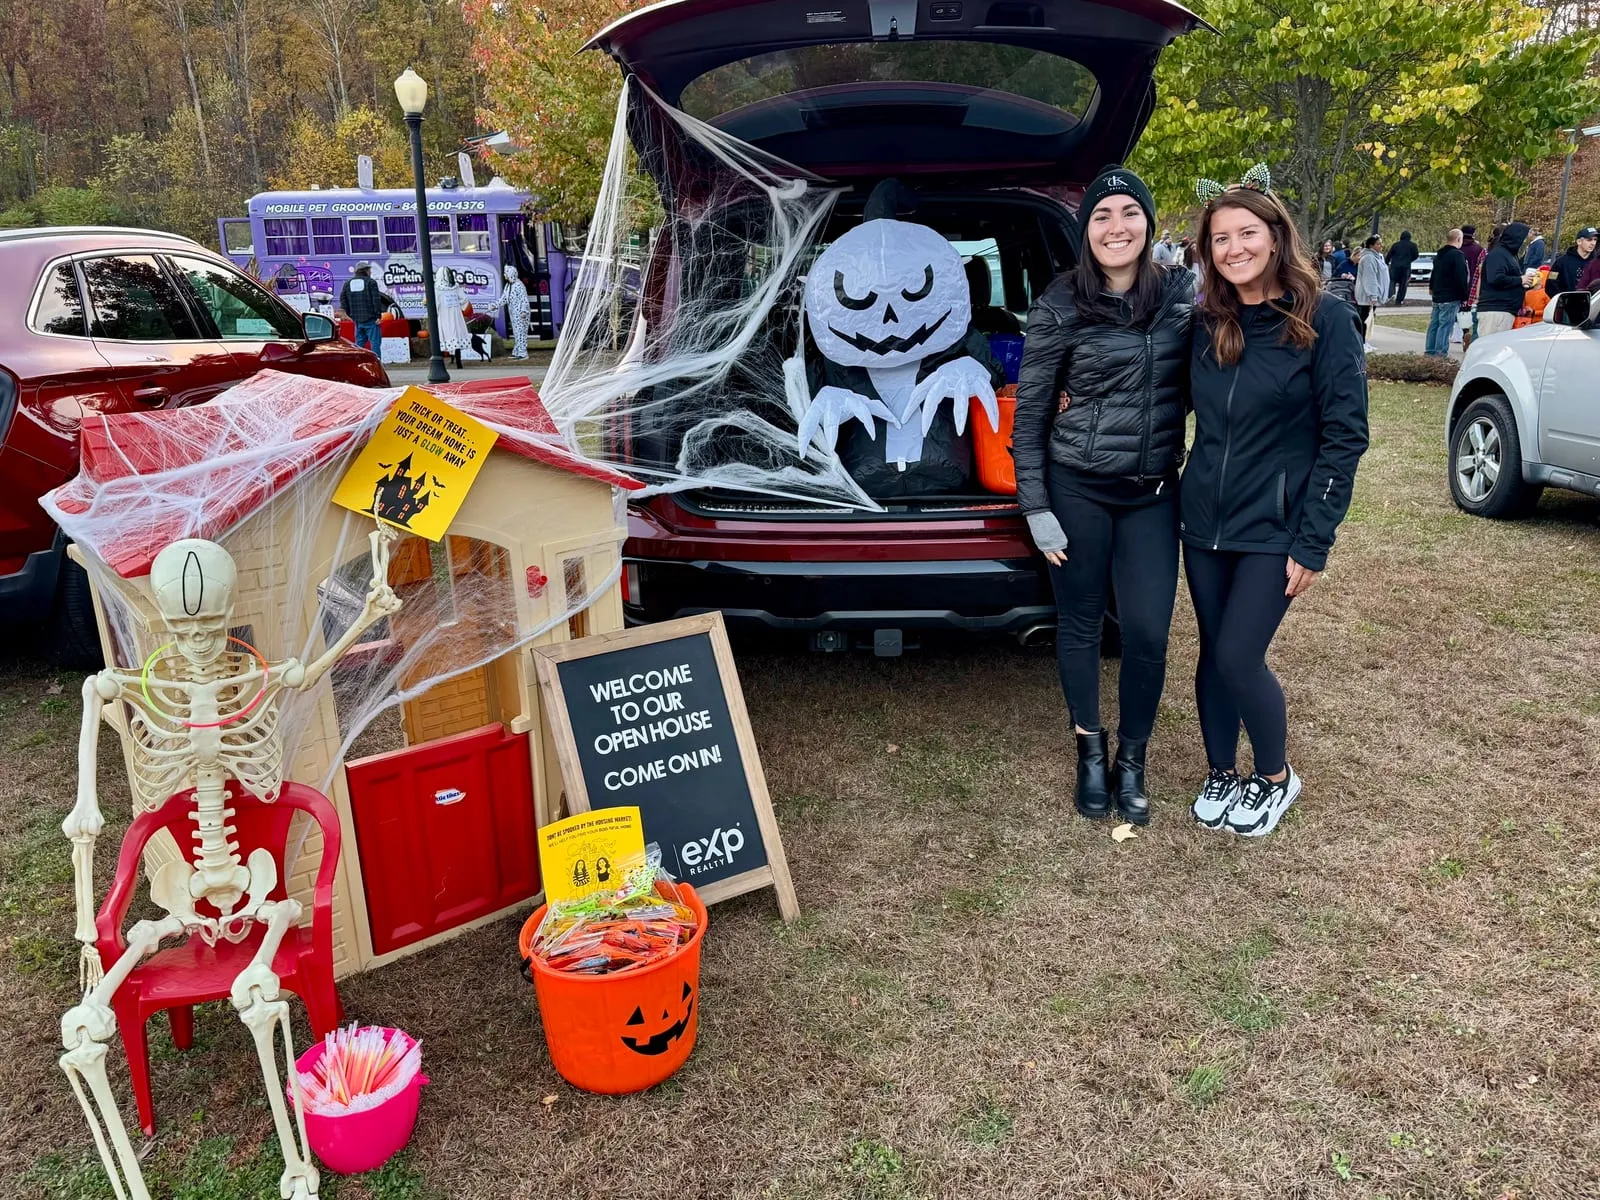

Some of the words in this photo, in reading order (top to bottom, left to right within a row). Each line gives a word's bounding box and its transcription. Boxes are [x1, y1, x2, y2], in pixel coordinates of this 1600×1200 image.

[266, 205, 304, 213] MOBILE
[308, 203, 327, 212] PET
[332, 202, 392, 212] GROOMING
[402, 201, 485, 211] 84-600-4376
[390, 265, 406, 273] The
[465, 273, 487, 285] Bus
[409, 401, 432, 419] TRICK
[431, 413, 443, 425] OR
[394, 425, 414, 440] JUST
[413, 435, 419, 445] A
[420, 438, 444, 457] GLOW
[443, 453, 466, 469] AWAY
[395, 409, 416, 427] YOUR
[416, 421, 442, 441] DREAM
[443, 435, 467, 454] HOME
[467, 449, 477, 460] IS
[589, 664, 692, 703] WELCOME
[610, 702, 639, 725] TO
[643, 692, 685, 716] OUR
[594, 727, 649, 755] OPEN
[651, 710, 713, 742] HOUSE
[604, 760, 666, 791] COME
[668, 750, 699, 774] ON
[700, 744, 722, 767] IN!
[562, 824, 580, 835] SPOOKED
[689, 858, 725, 875] REALTY
